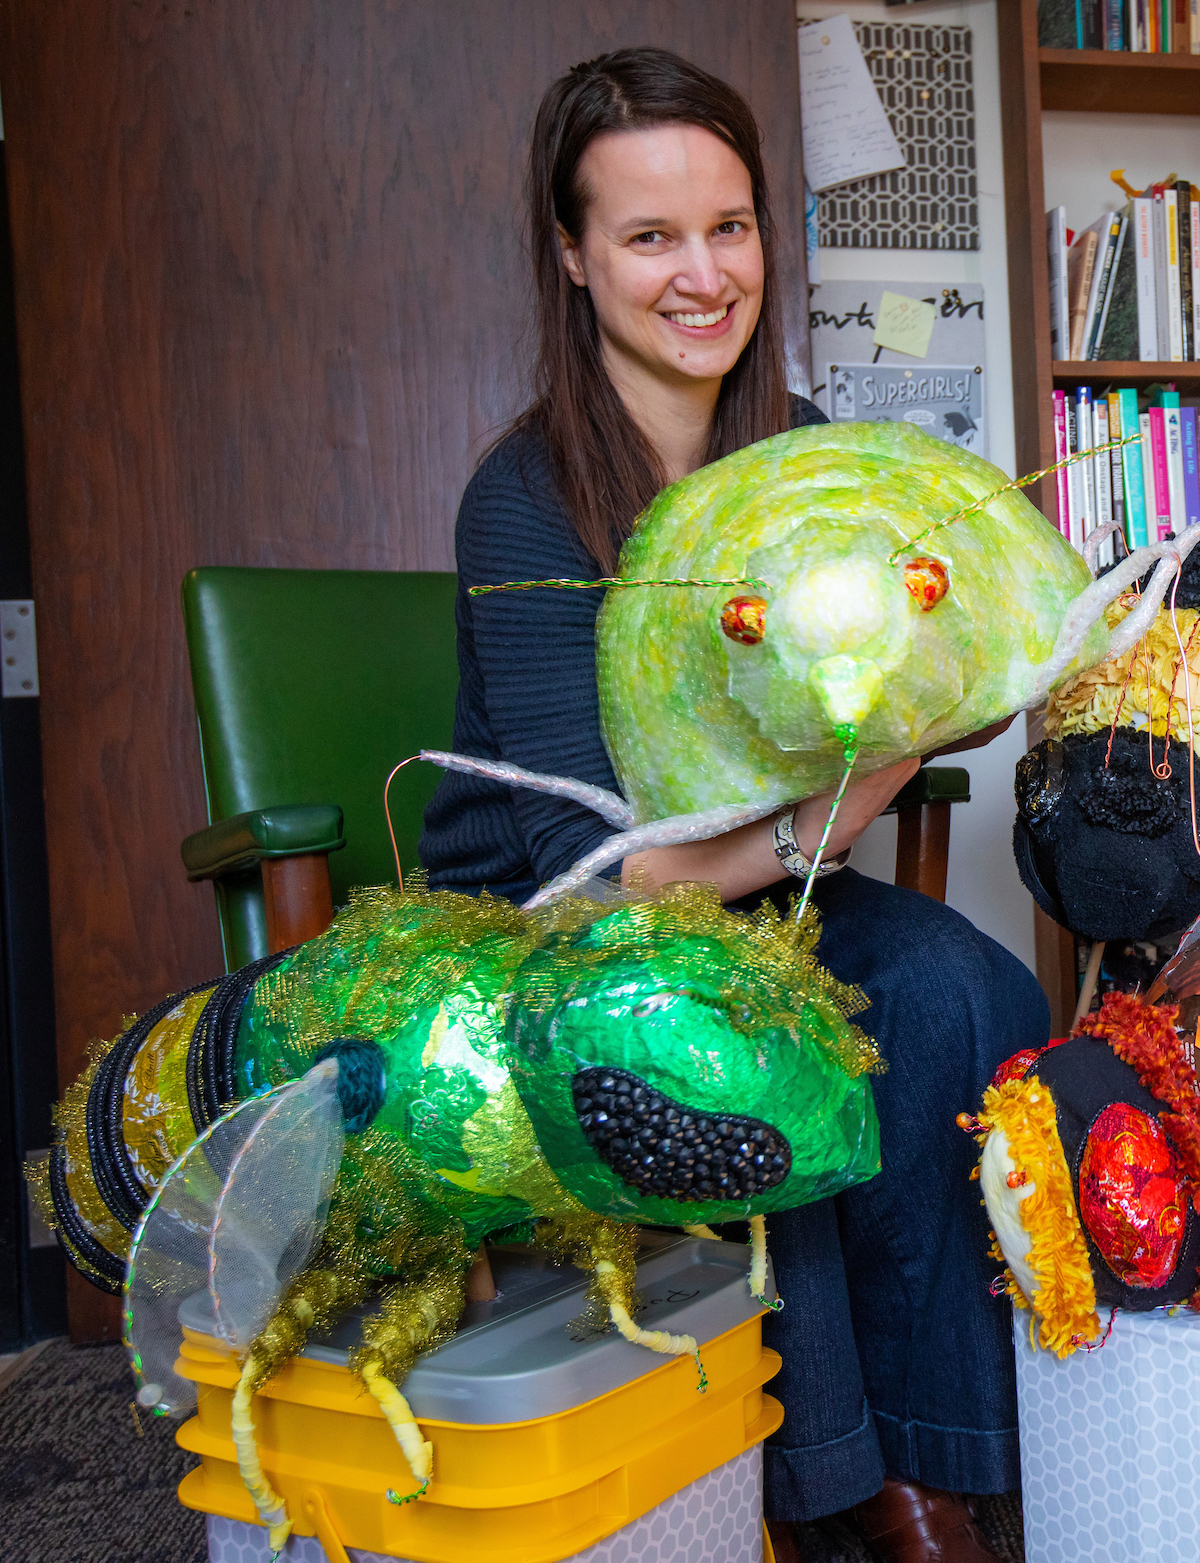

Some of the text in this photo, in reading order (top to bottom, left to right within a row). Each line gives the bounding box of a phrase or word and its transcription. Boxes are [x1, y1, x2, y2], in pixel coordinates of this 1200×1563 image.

[862, 374, 971, 406] SUPERGIRLS!
[1185, 421, 1193, 446] Acting
[1098, 461, 1106, 490] Onstage
[1113, 464, 1123, 500] TRAINING
[1133, 496, 1142, 512] Two
[156, 1128, 174, 1163] LINDOR
[1119, 1199, 1149, 1230] LINDOR
